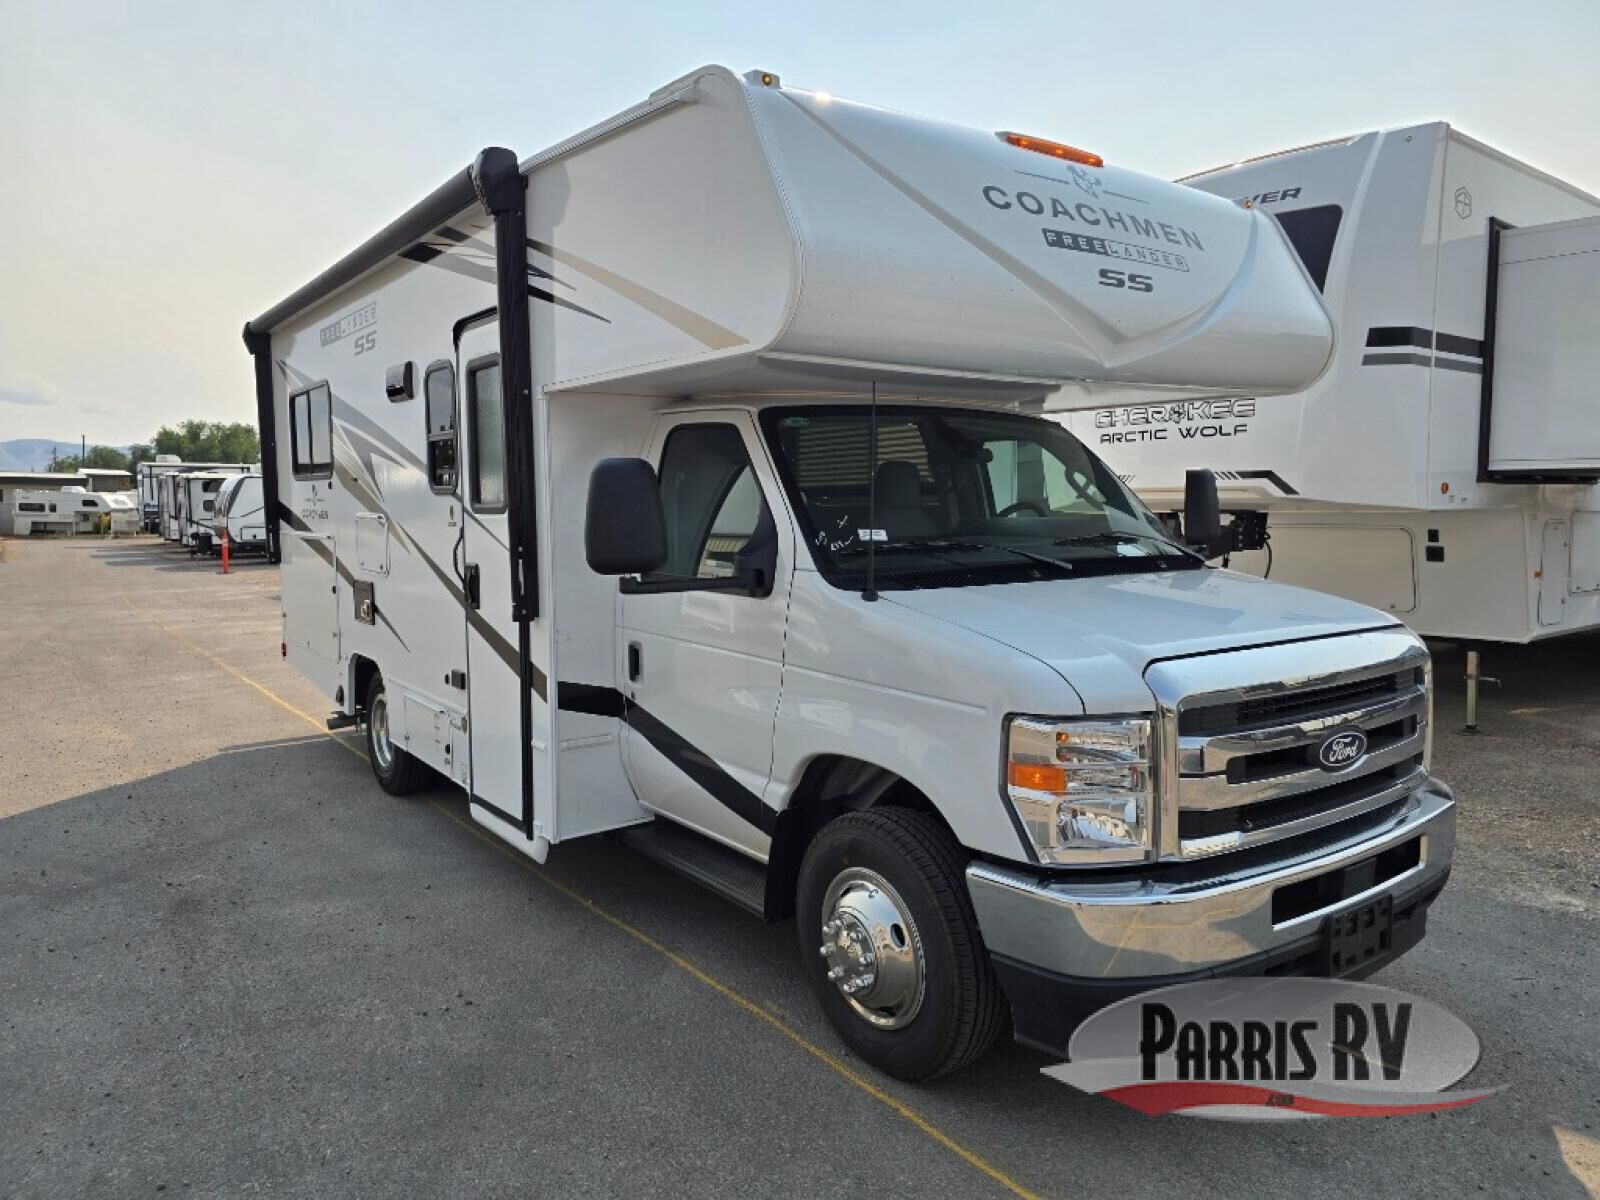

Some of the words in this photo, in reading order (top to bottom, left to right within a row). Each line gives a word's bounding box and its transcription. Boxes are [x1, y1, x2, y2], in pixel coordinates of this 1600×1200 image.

[982, 185, 1205, 251] COACHMEN
[1045, 231, 1187, 268] FREELANDER
[1098, 268, 1154, 293] SS
[353, 330, 377, 357] SS
[1100, 429, 1168, 444] ARCTIC
[1178, 424, 1248, 439] WOLF
[1329, 736, 1359, 762] Ford
